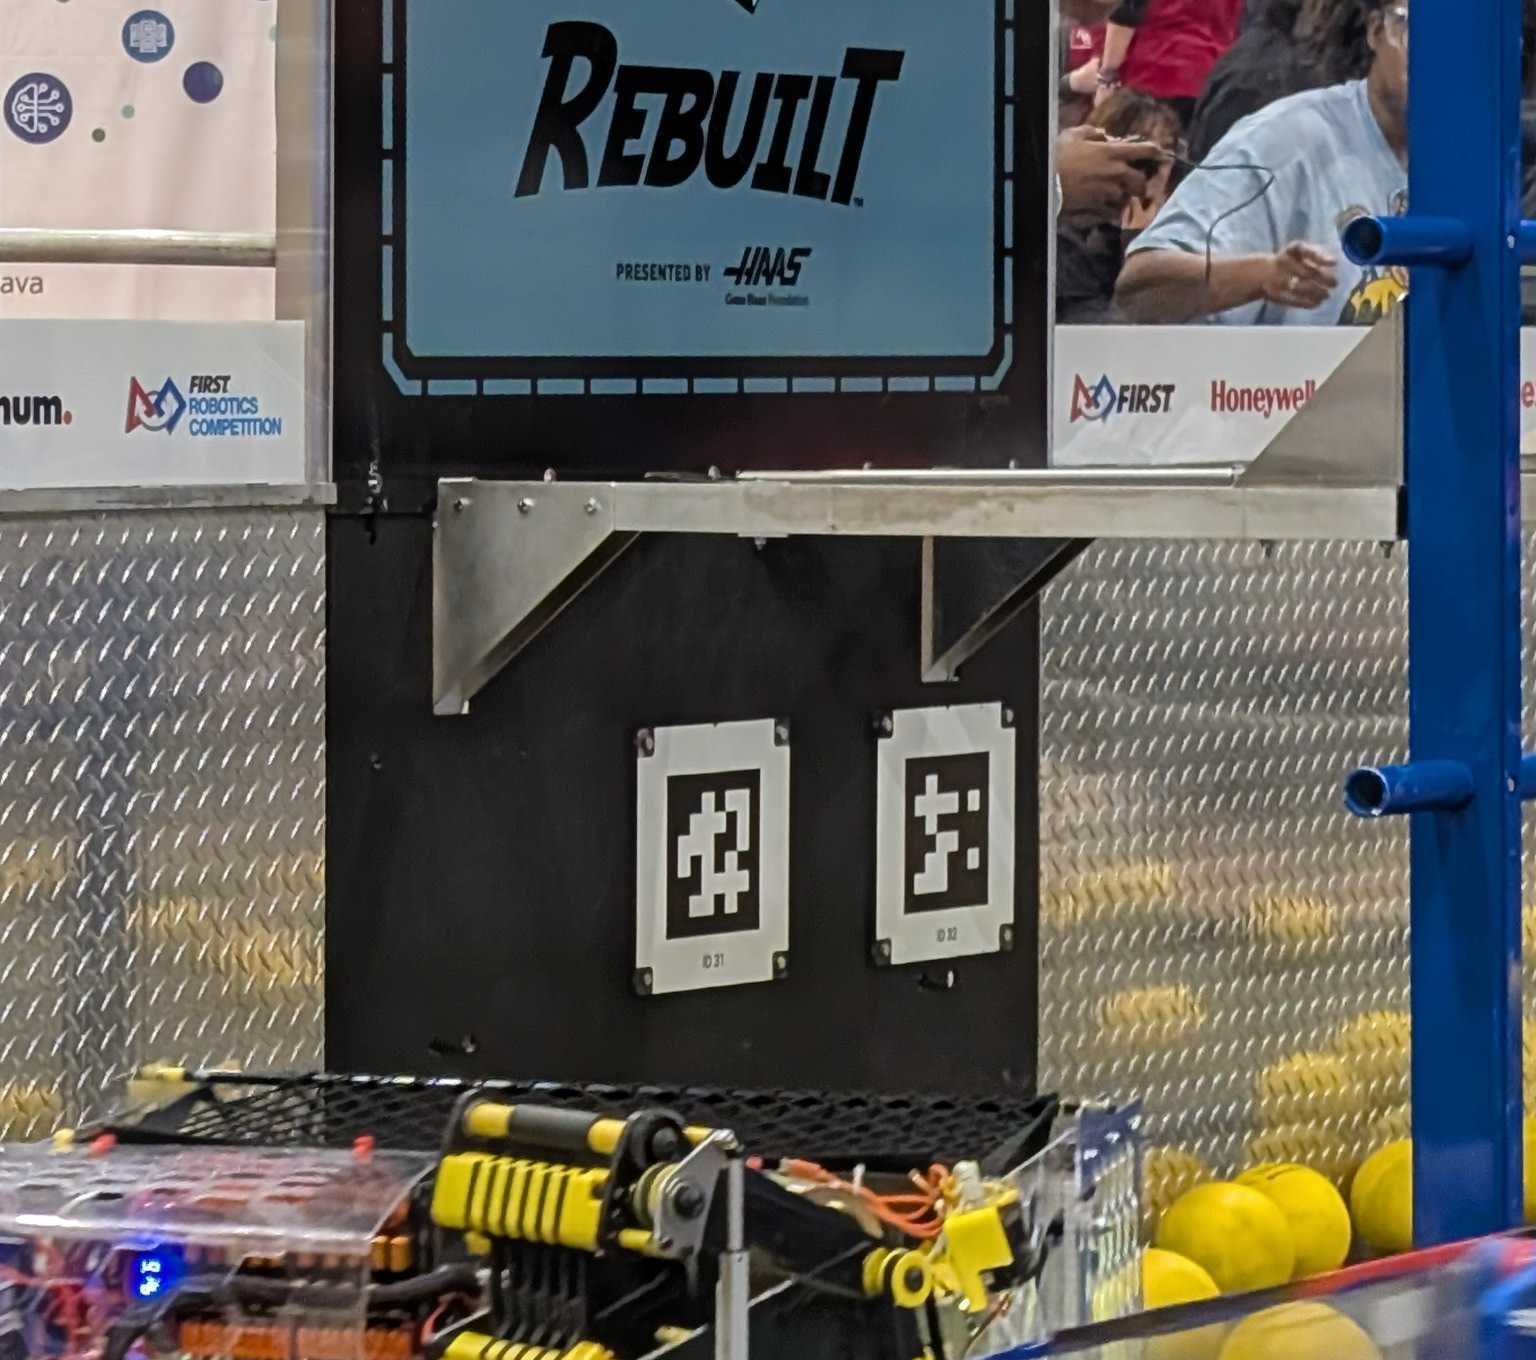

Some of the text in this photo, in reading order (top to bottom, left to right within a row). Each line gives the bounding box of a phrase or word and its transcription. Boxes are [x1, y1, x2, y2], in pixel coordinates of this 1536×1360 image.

[514, 20, 905, 206] REBUILT
[616, 246, 812, 287] PRESENTED BY HAAS
[0, 275, 44, 294] ava
[189, 375, 231, 394] FIRST
[189, 396, 259, 415] ROBOTICS
[1116, 383, 1176, 414] FIRST
[189, 417, 282, 436] COMPETITION
